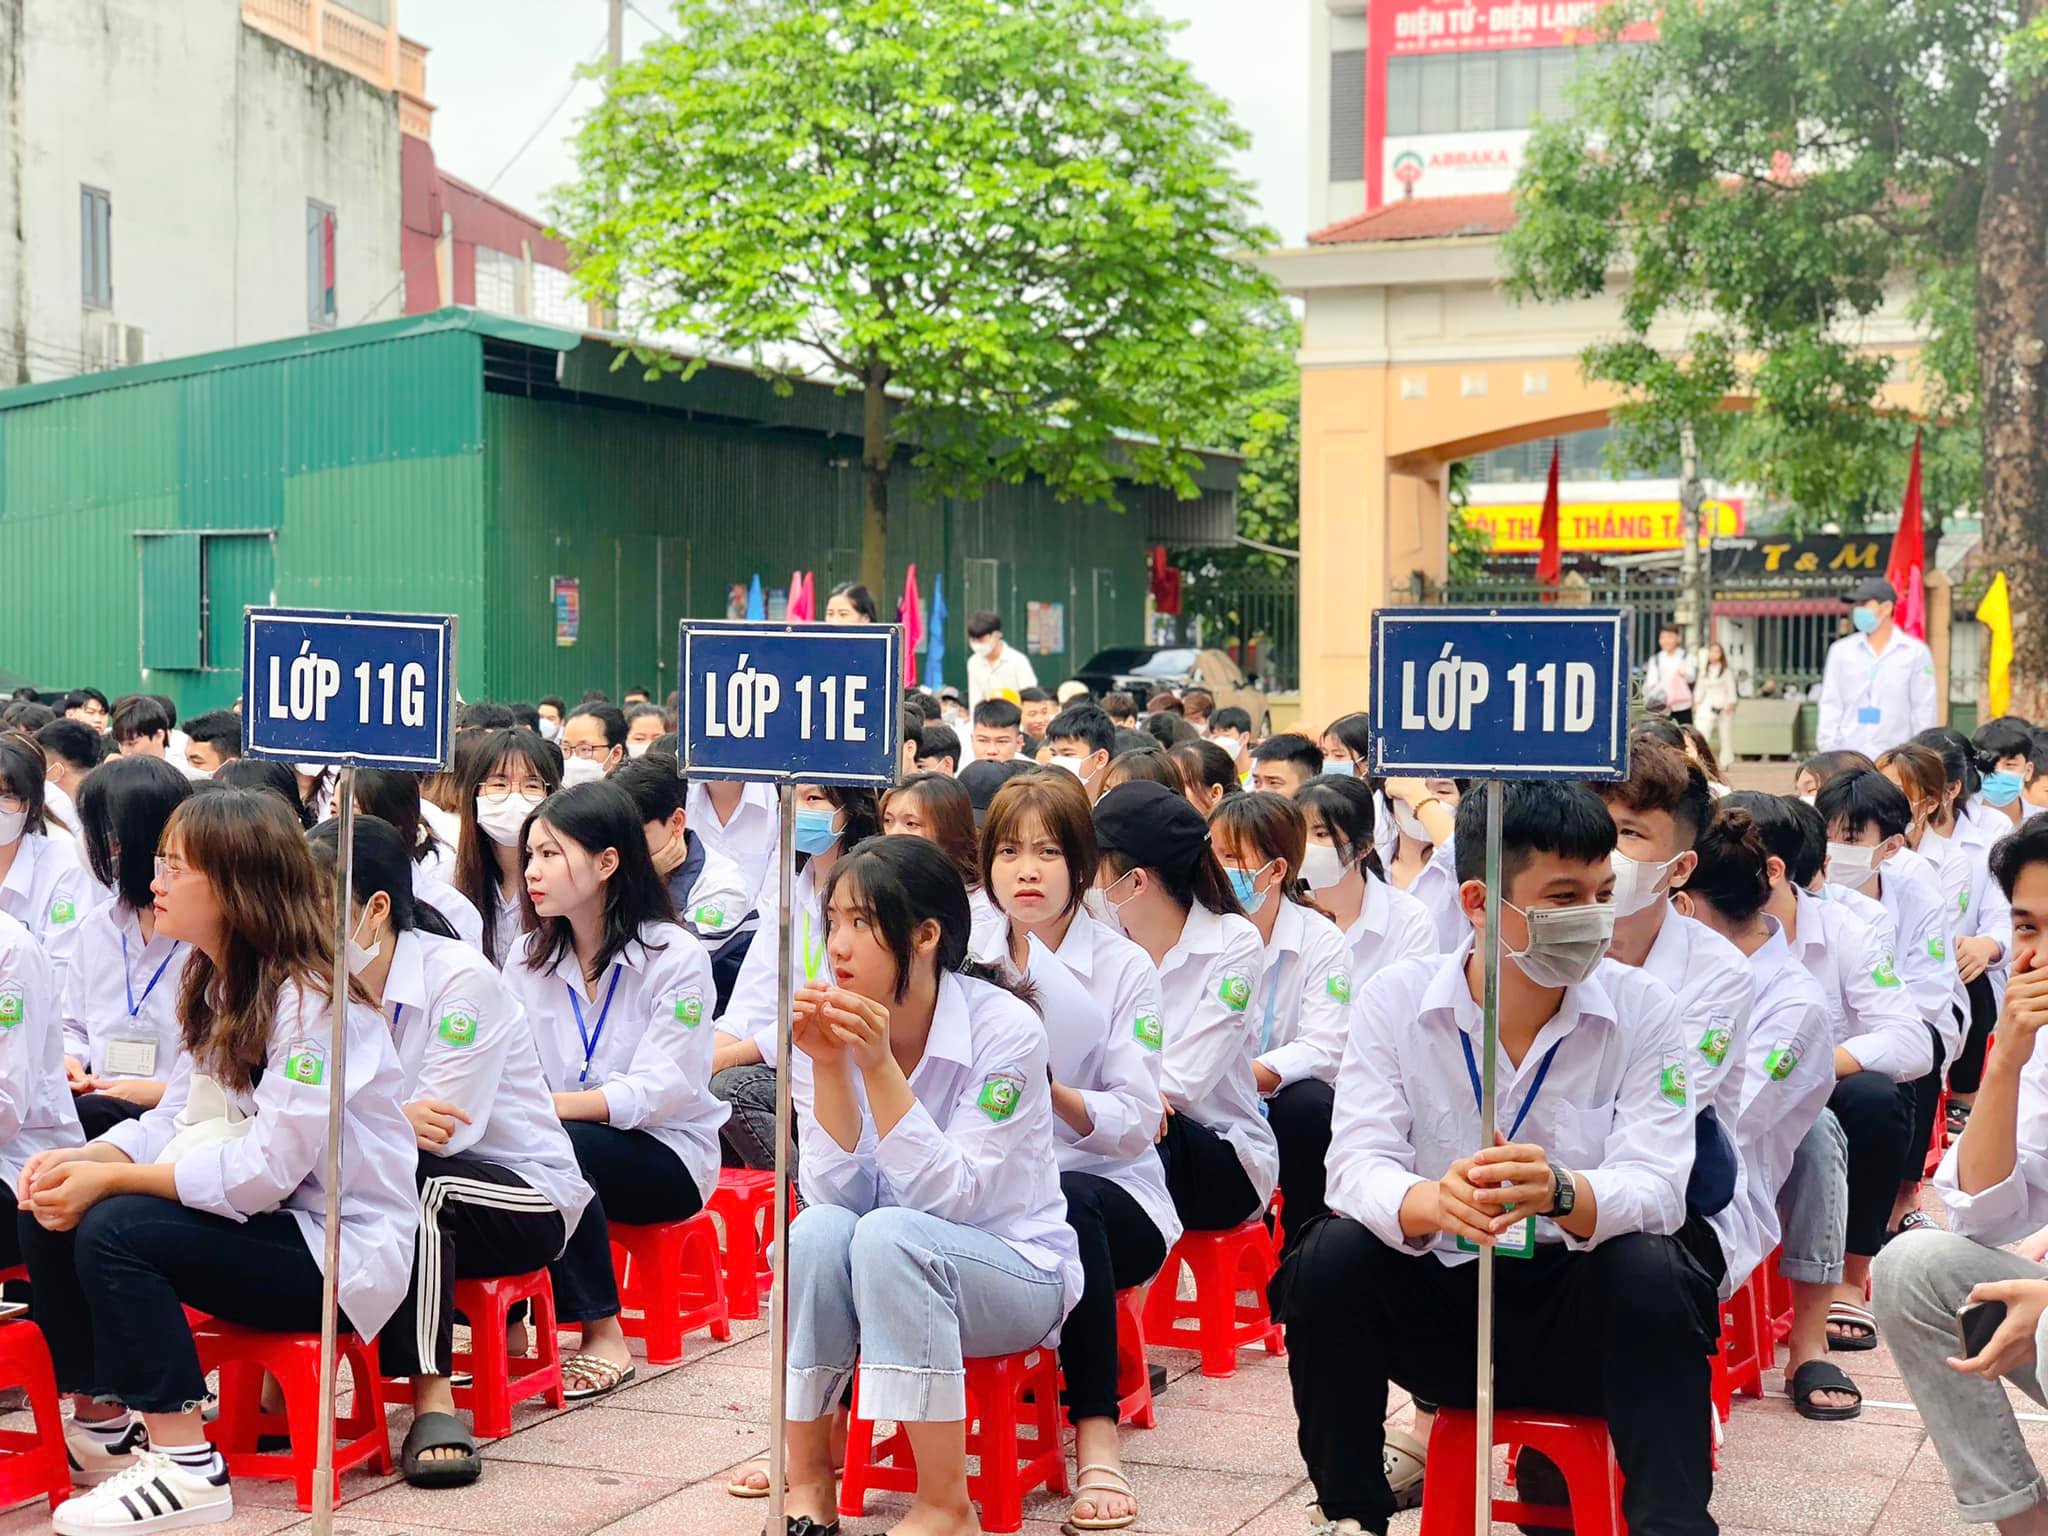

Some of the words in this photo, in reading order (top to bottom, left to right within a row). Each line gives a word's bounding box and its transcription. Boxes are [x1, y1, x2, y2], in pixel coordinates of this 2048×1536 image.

[1572, 503, 1652, 539] THÁNG
[1762, 543, 1792, 572] T
[1794, 552, 1819, 571] &
[1829, 543, 1879, 570] M
[269, 639, 341, 721] LỚP
[354, 661, 426, 727] 11G
[705, 653, 780, 738] LỚP
[795, 674, 868, 741] 11E
[1401, 641, 1490, 731] LỚP
[1506, 661, 1596, 732] 11D
